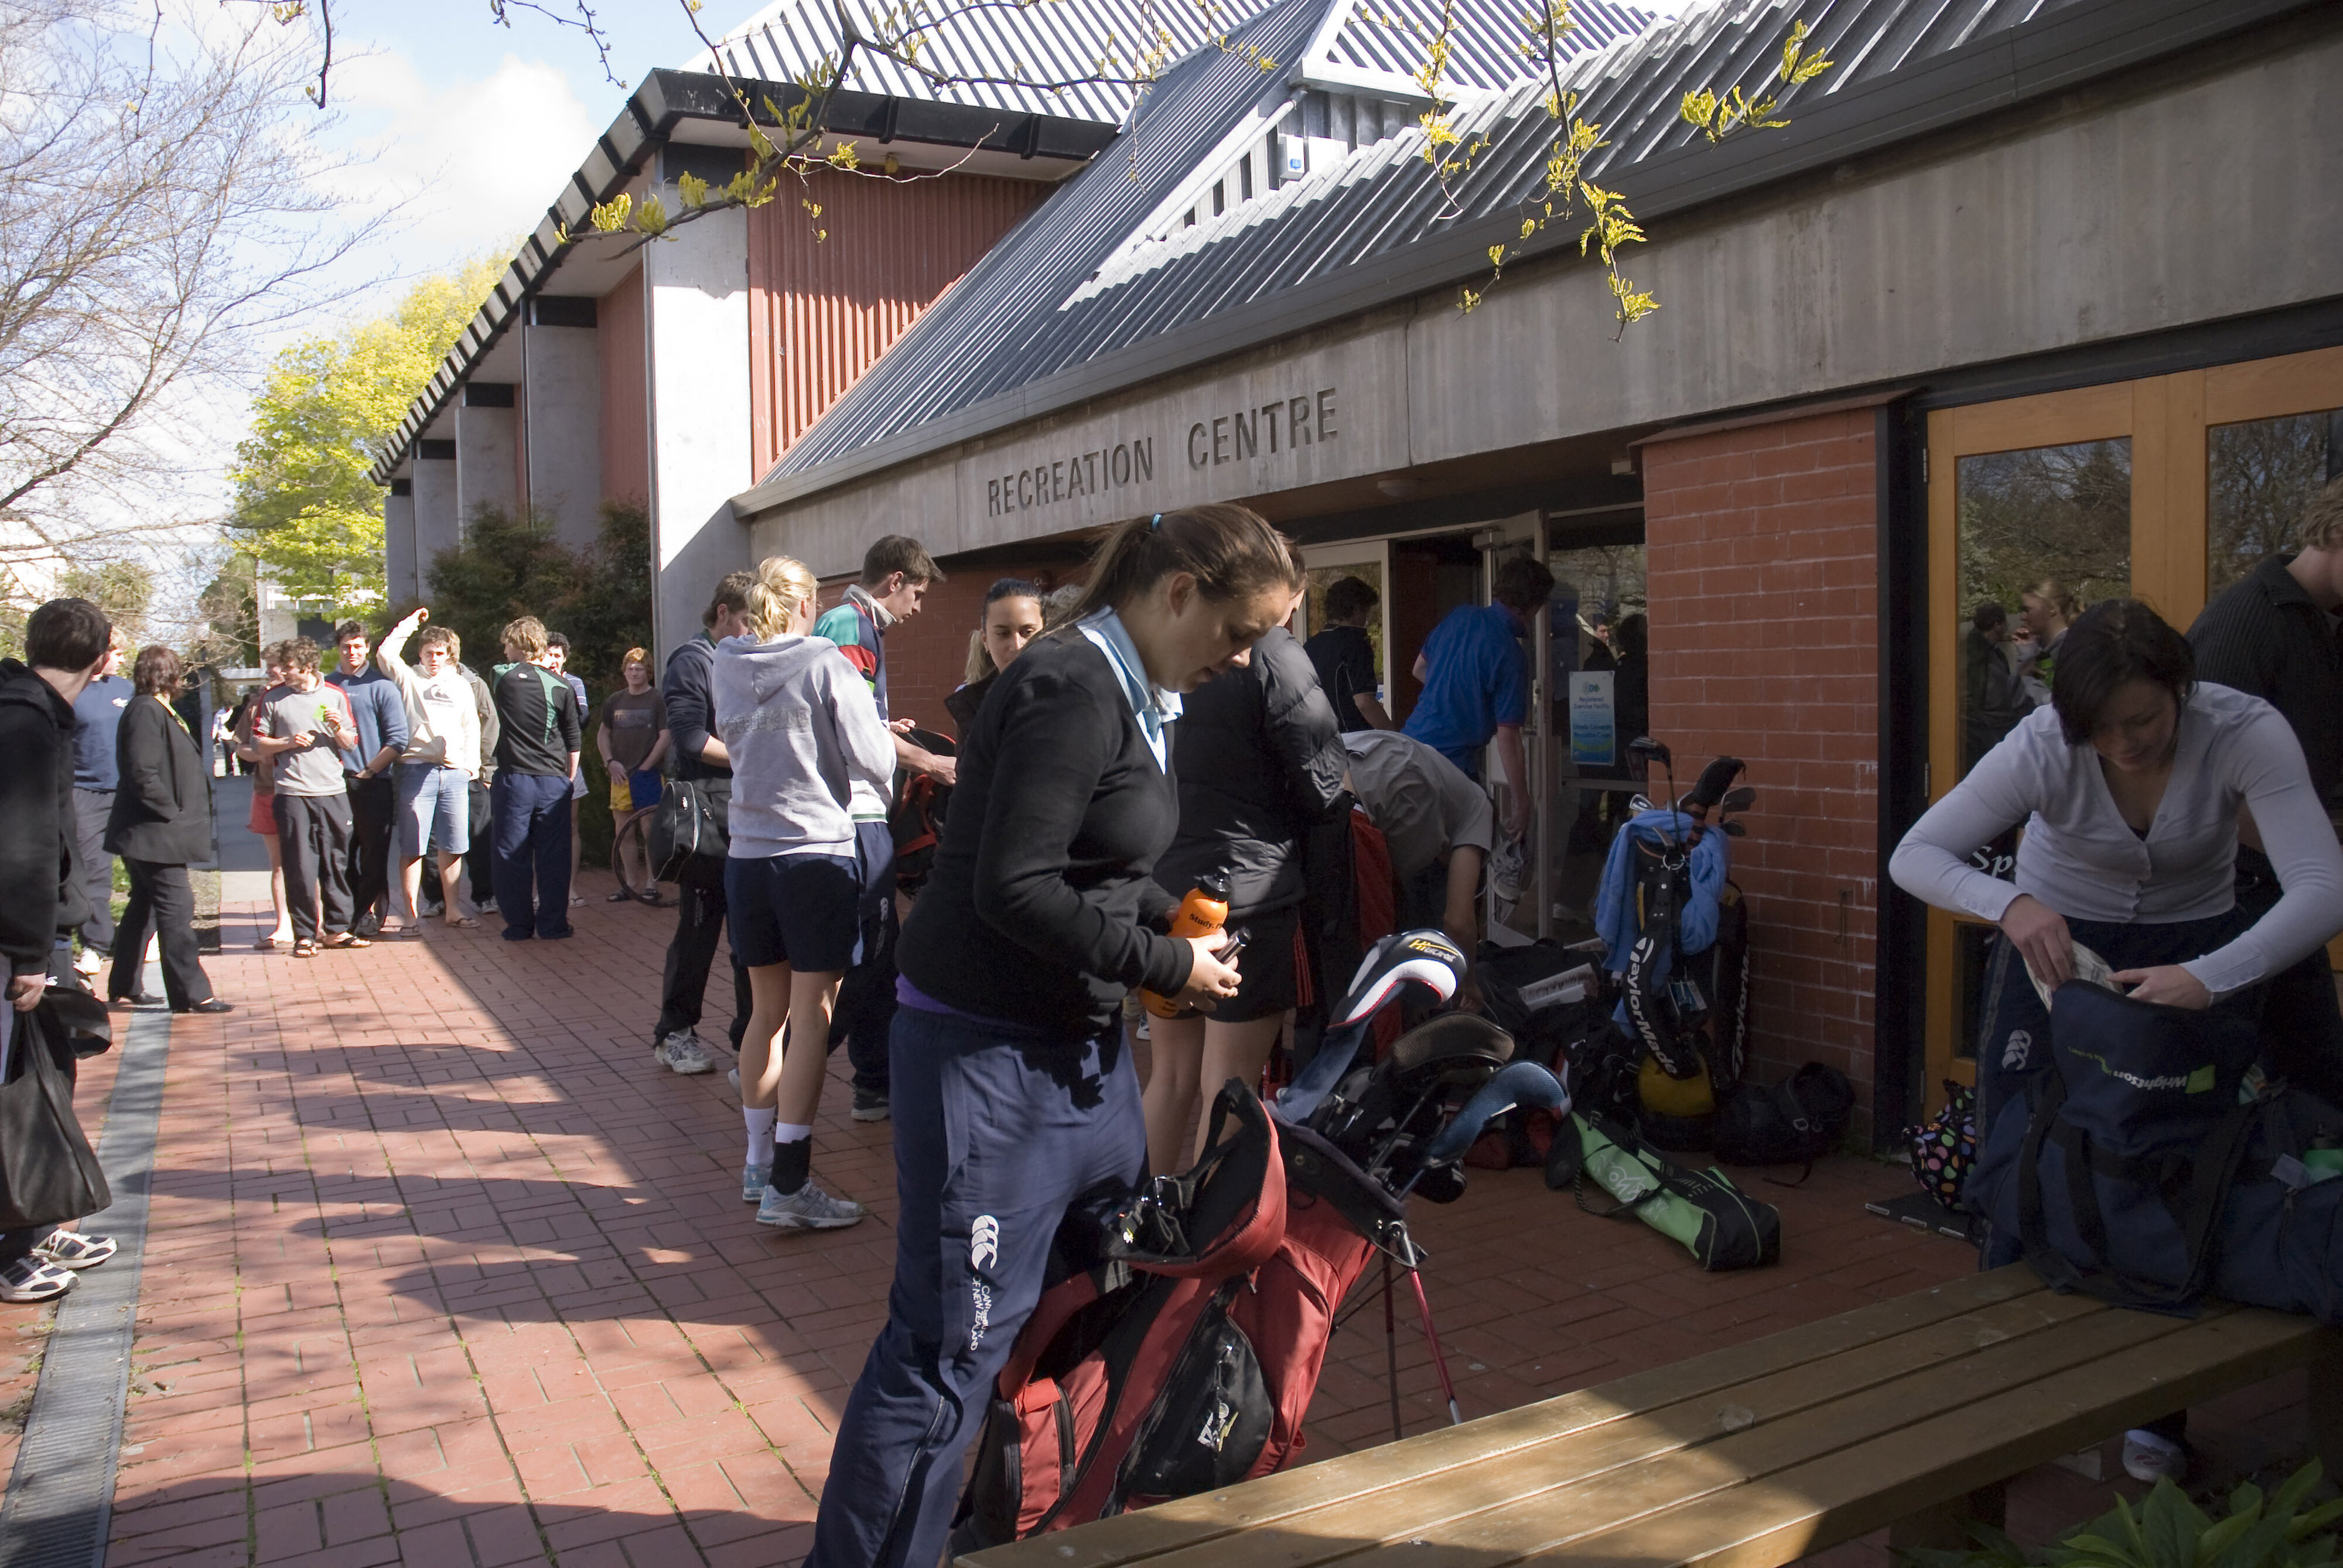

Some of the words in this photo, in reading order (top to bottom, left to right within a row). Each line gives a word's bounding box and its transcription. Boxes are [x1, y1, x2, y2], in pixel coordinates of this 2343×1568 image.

[988, 437, 1153, 517] RECREATION
[1187, 387, 1338, 471] CENTRE
[1967, 845, 2017, 877] Sp
[1627, 937, 1677, 1074] TaylorMade
[2113, 1070, 2188, 1091] Wrightson
[972, 1275, 981, 1287] OF
[972, 1288, 983, 1310] NEW
[970, 1310, 983, 1351] ZEALAND
